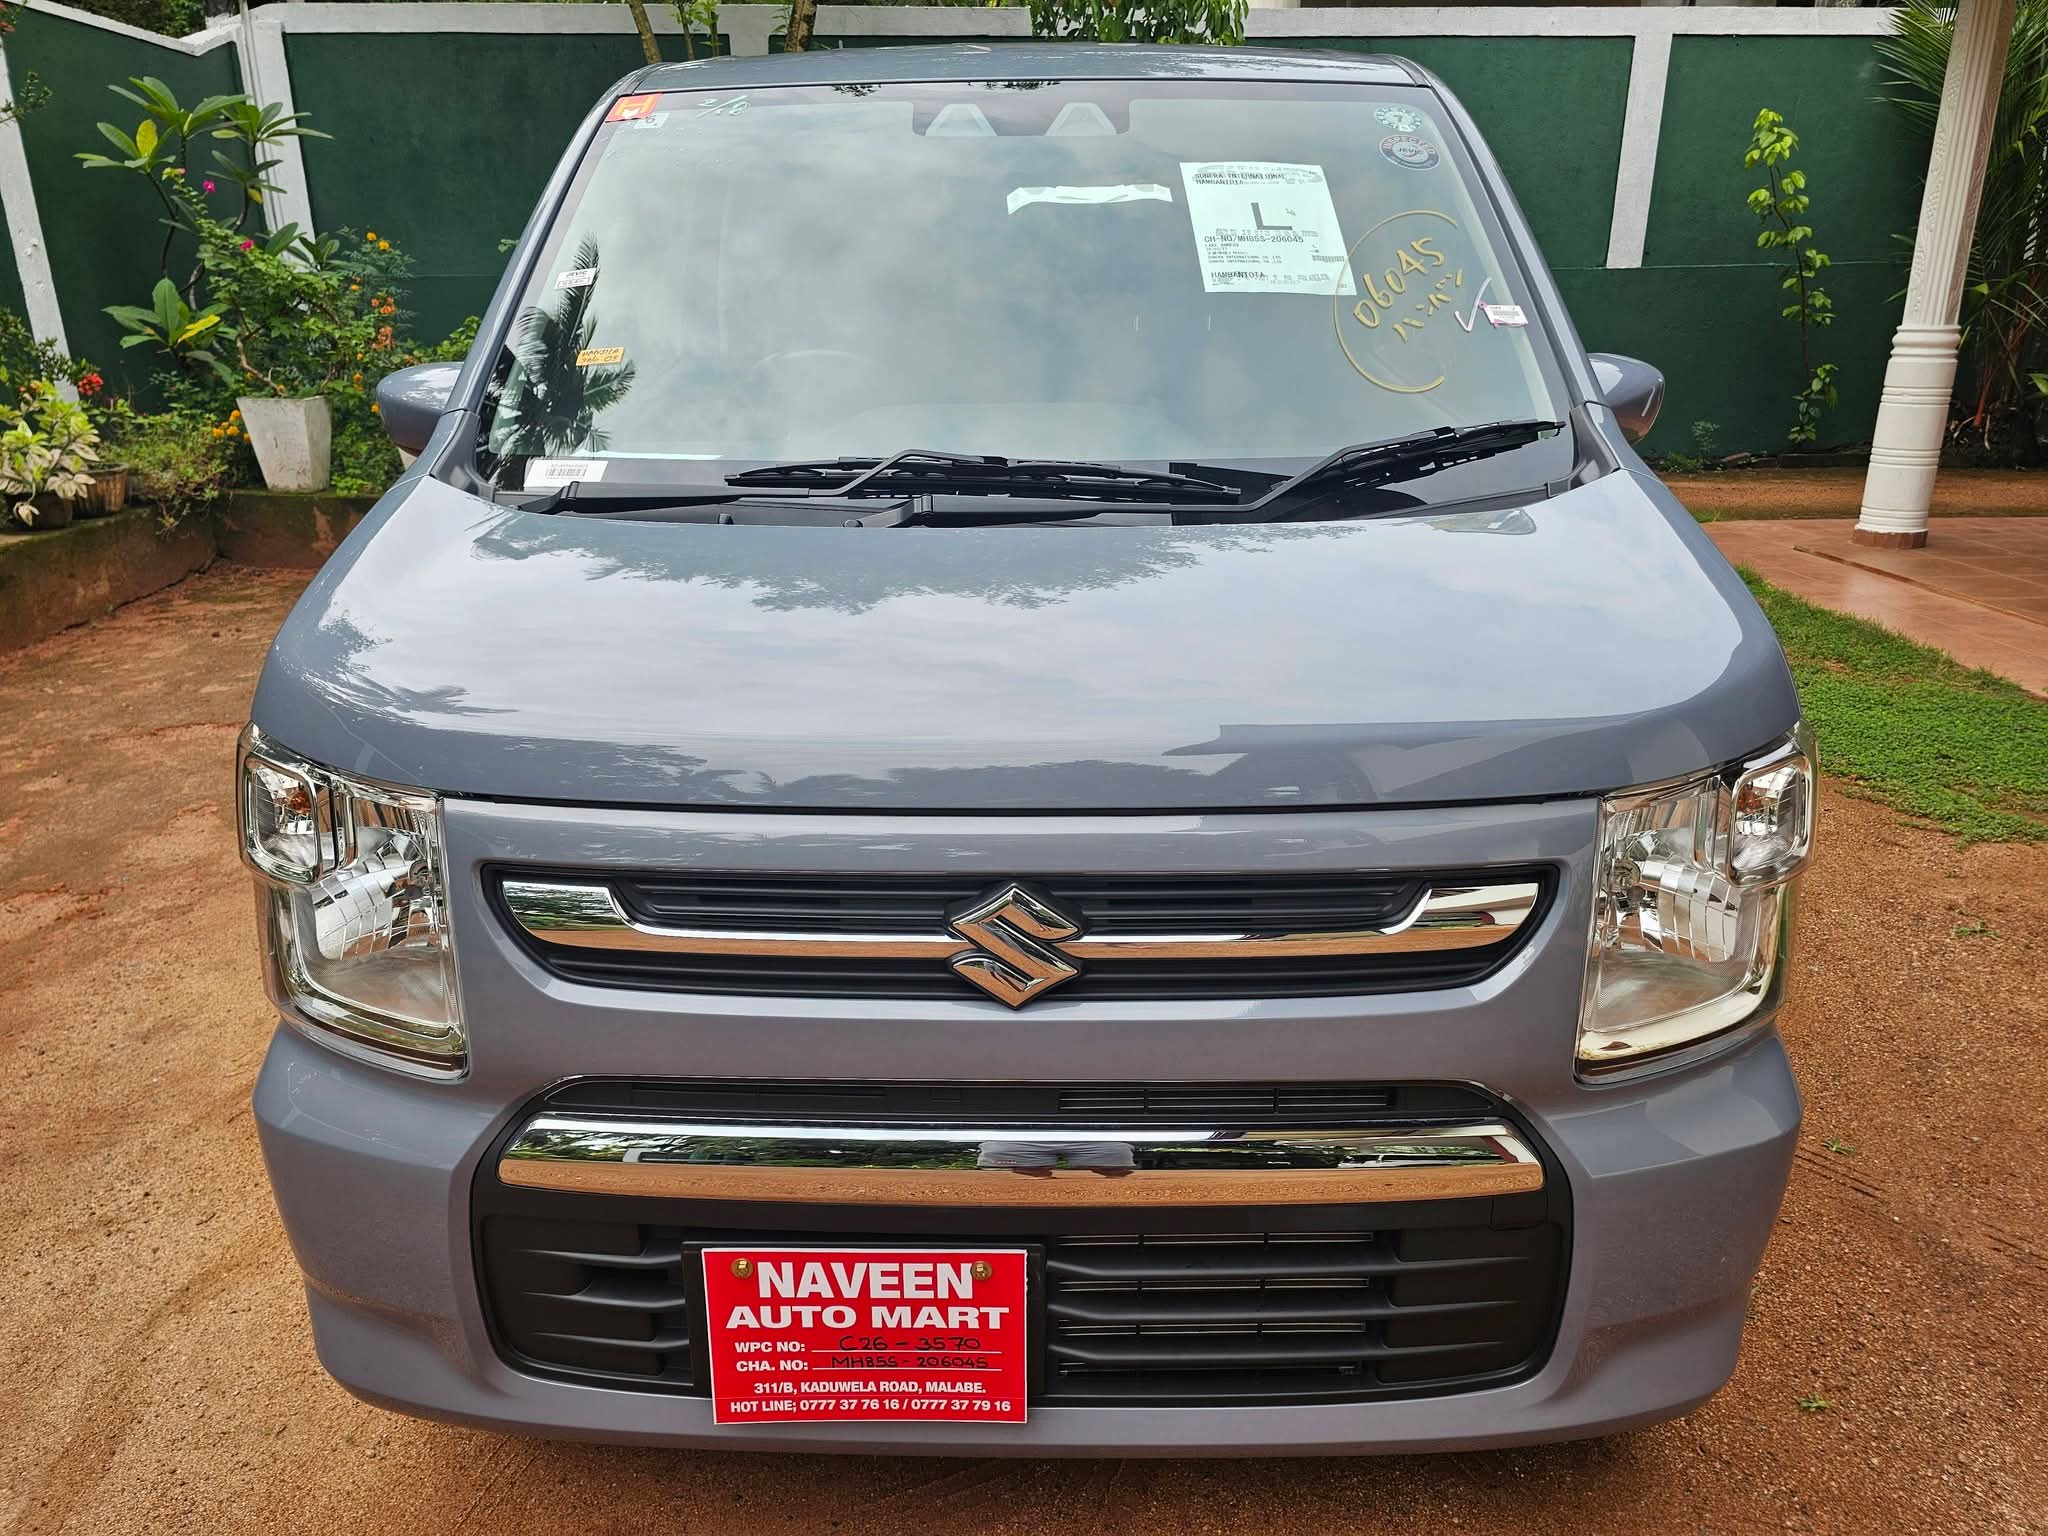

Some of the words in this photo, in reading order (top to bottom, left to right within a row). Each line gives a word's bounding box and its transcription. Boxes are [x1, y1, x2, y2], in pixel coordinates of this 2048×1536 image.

[1250, 202, 1293, 231] L
[1210, 271, 1266, 279] HAMBANTOTA
[1353, 237, 1446, 329] 06045
[757, 1262, 974, 1299] NAVEEN
[726, 1305, 857, 1329] AUTO
[871, 1306, 1010, 1330] MART
[734, 1341, 773, 1353] WPC
[776, 1341, 806, 1352] NO:
[736, 1360, 776, 1372] CHA.
[779, 1360, 809, 1371] NO:
[754, 1382, 798, 1395] 311/B,
[800, 1381, 877, 1393] KADUWELA
[879, 1381, 923, 1394] ROAD,
[925, 1381, 987, 1393] MALABE.
[730, 1401, 759, 1413] HOT
[761, 1400, 797, 1413] LINE;
[799, 1399, 836, 1411] 0777
[839, 1399, 858, 1411] 37
[861, 1399, 880, 1410] 76
[882, 1399, 900, 1410] 16
[911, 1399, 948, 1410] 0777
[950, 1399, 969, 1411] 37
[972, 1400, 991, 1411] 79
[994, 1400, 1011, 1412] 16
